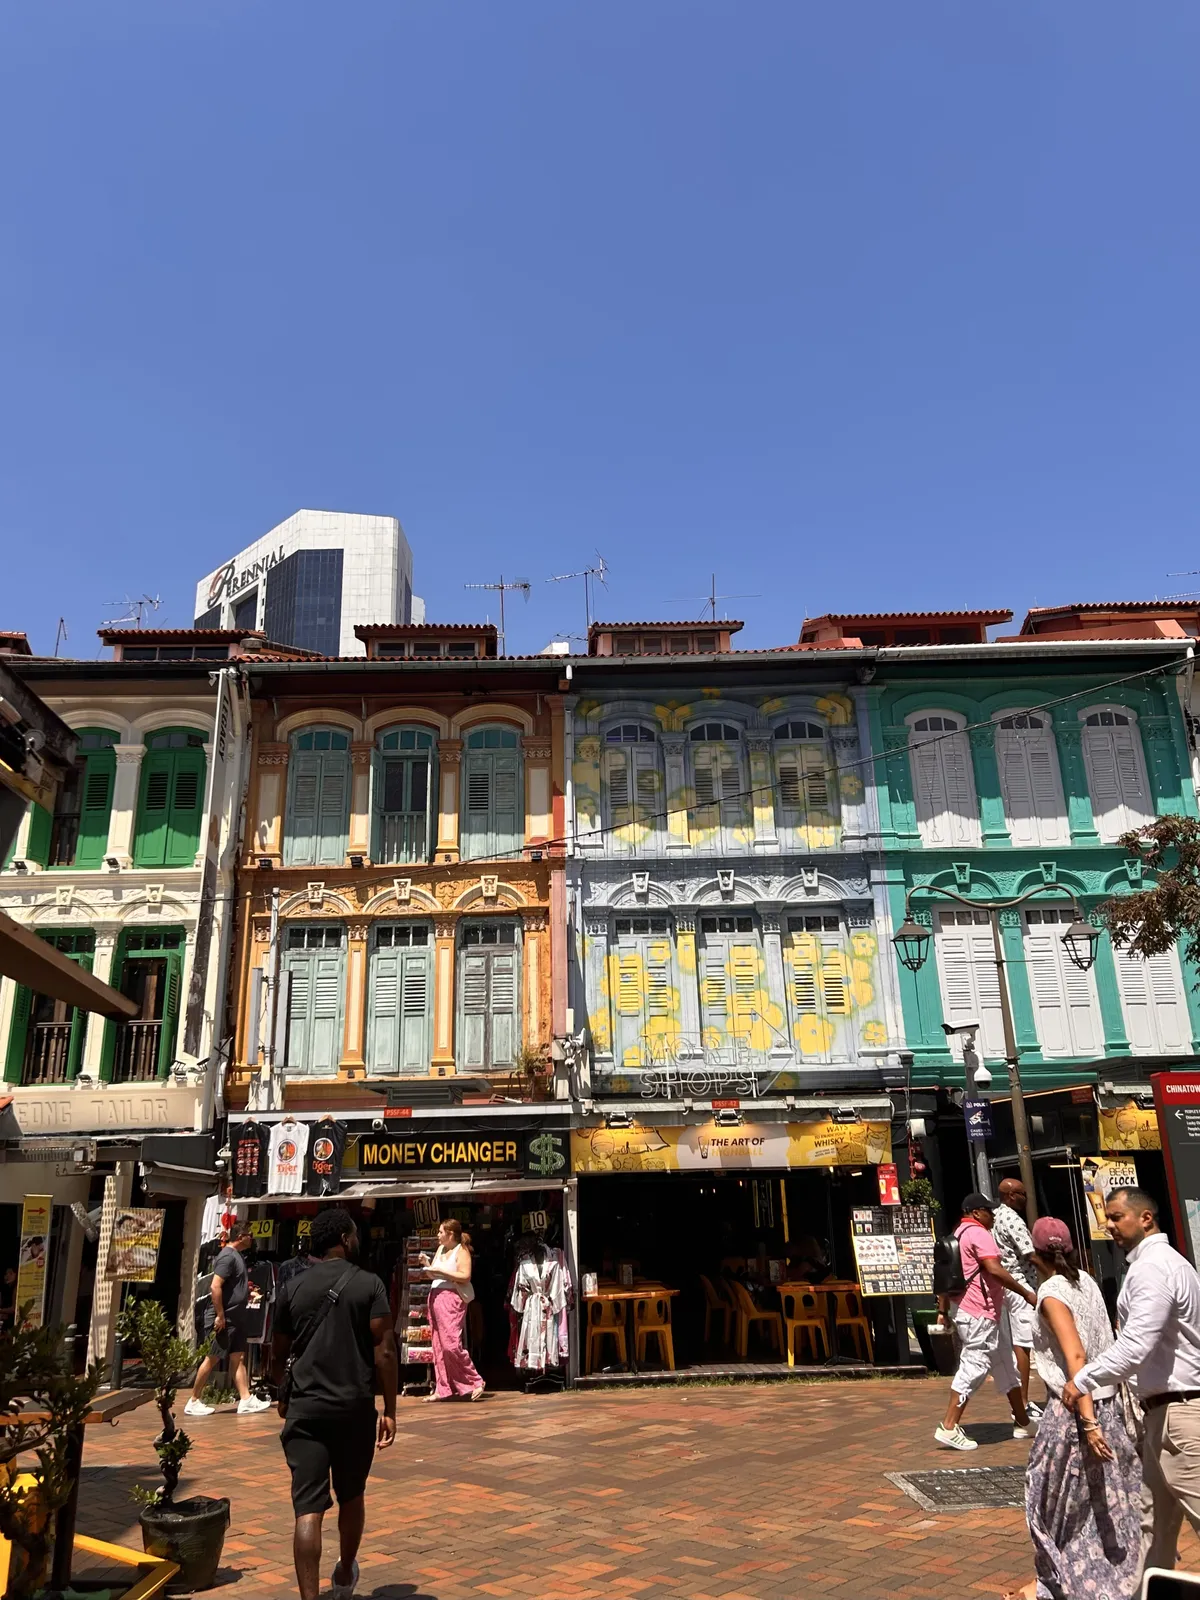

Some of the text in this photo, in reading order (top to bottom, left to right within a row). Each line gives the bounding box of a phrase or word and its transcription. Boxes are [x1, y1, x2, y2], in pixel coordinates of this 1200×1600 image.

[219, 695, 229, 763] LEGACY
[640, 1066, 754, 1099] SHOPS
[91, 1098, 168, 1124] TAILOR
[826, 1124, 848, 1133] WAYS
[711, 1137, 765, 1147] THE ART OF
[814, 1136, 845, 1148] WHISKY
[363, 1140, 517, 1165] MONEY CHANGER
[1109, 1167, 1135, 1176] BEER
[1109, 1176, 1136, 1186] CLOCK
[532, 1211, 545, 1228] 10
[257, 1220, 271, 1234] 10
